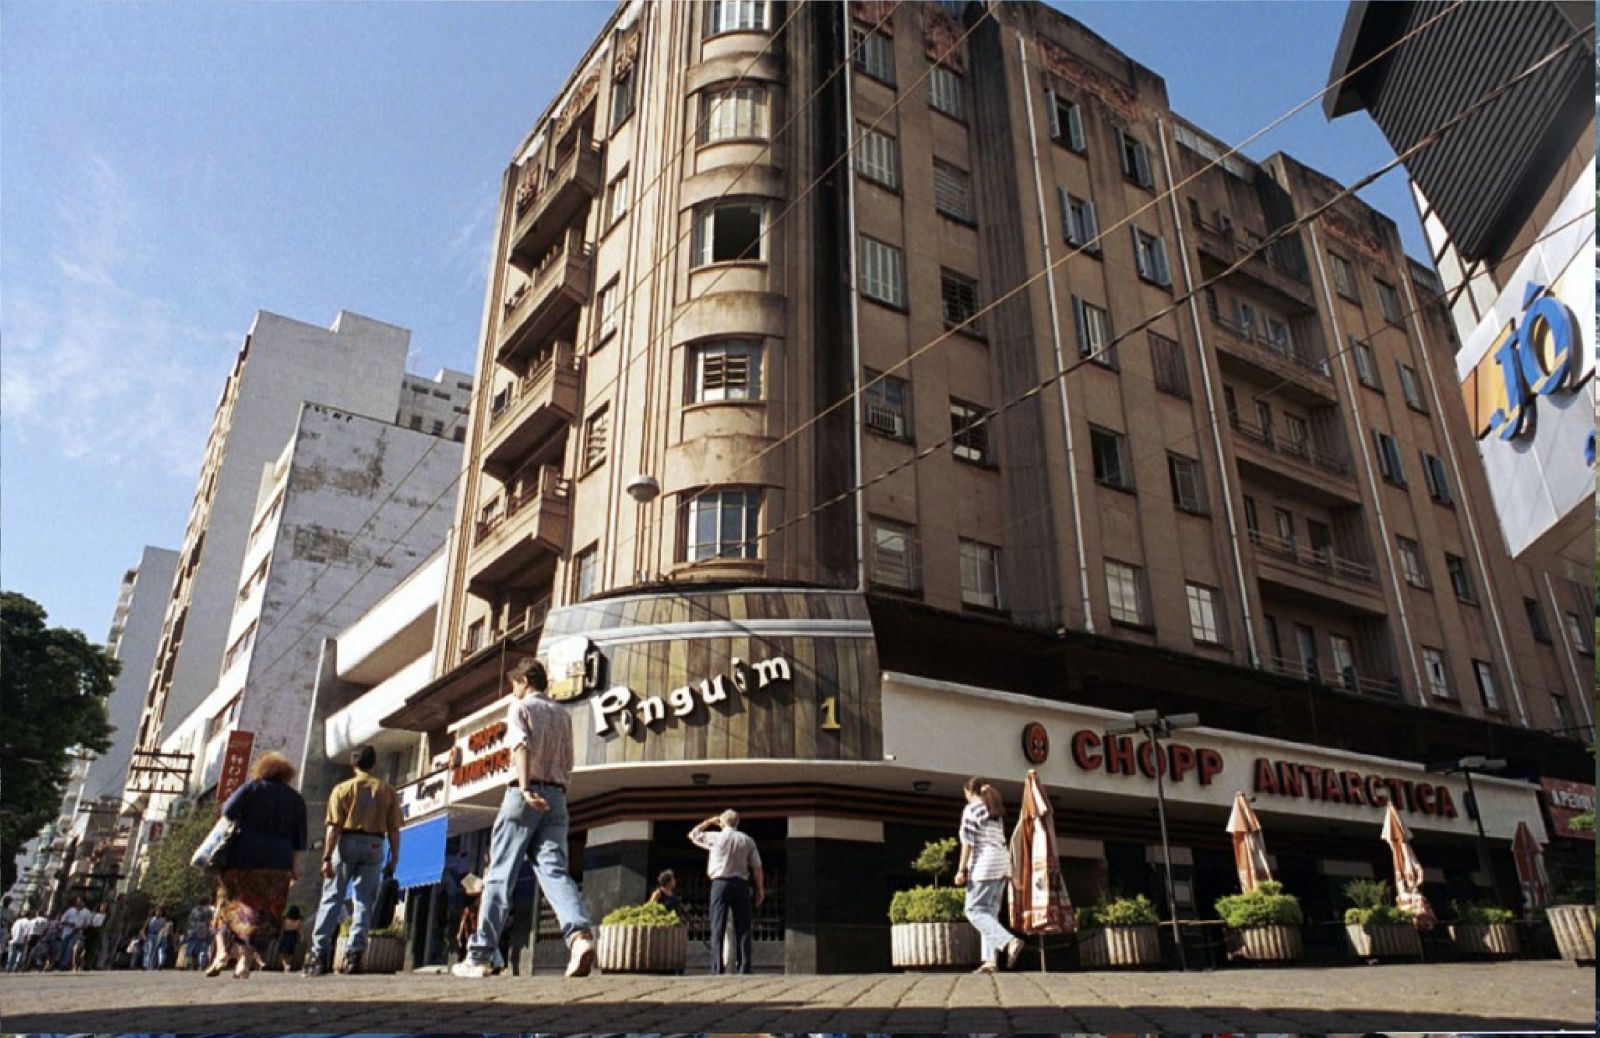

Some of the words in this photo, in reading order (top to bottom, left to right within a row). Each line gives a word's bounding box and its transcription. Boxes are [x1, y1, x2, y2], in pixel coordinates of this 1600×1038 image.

[820, 695, 841, 730] 1
[1071, 729, 1225, 786] CHOPP
[1254, 757, 1458, 819] ANTARCTICA
